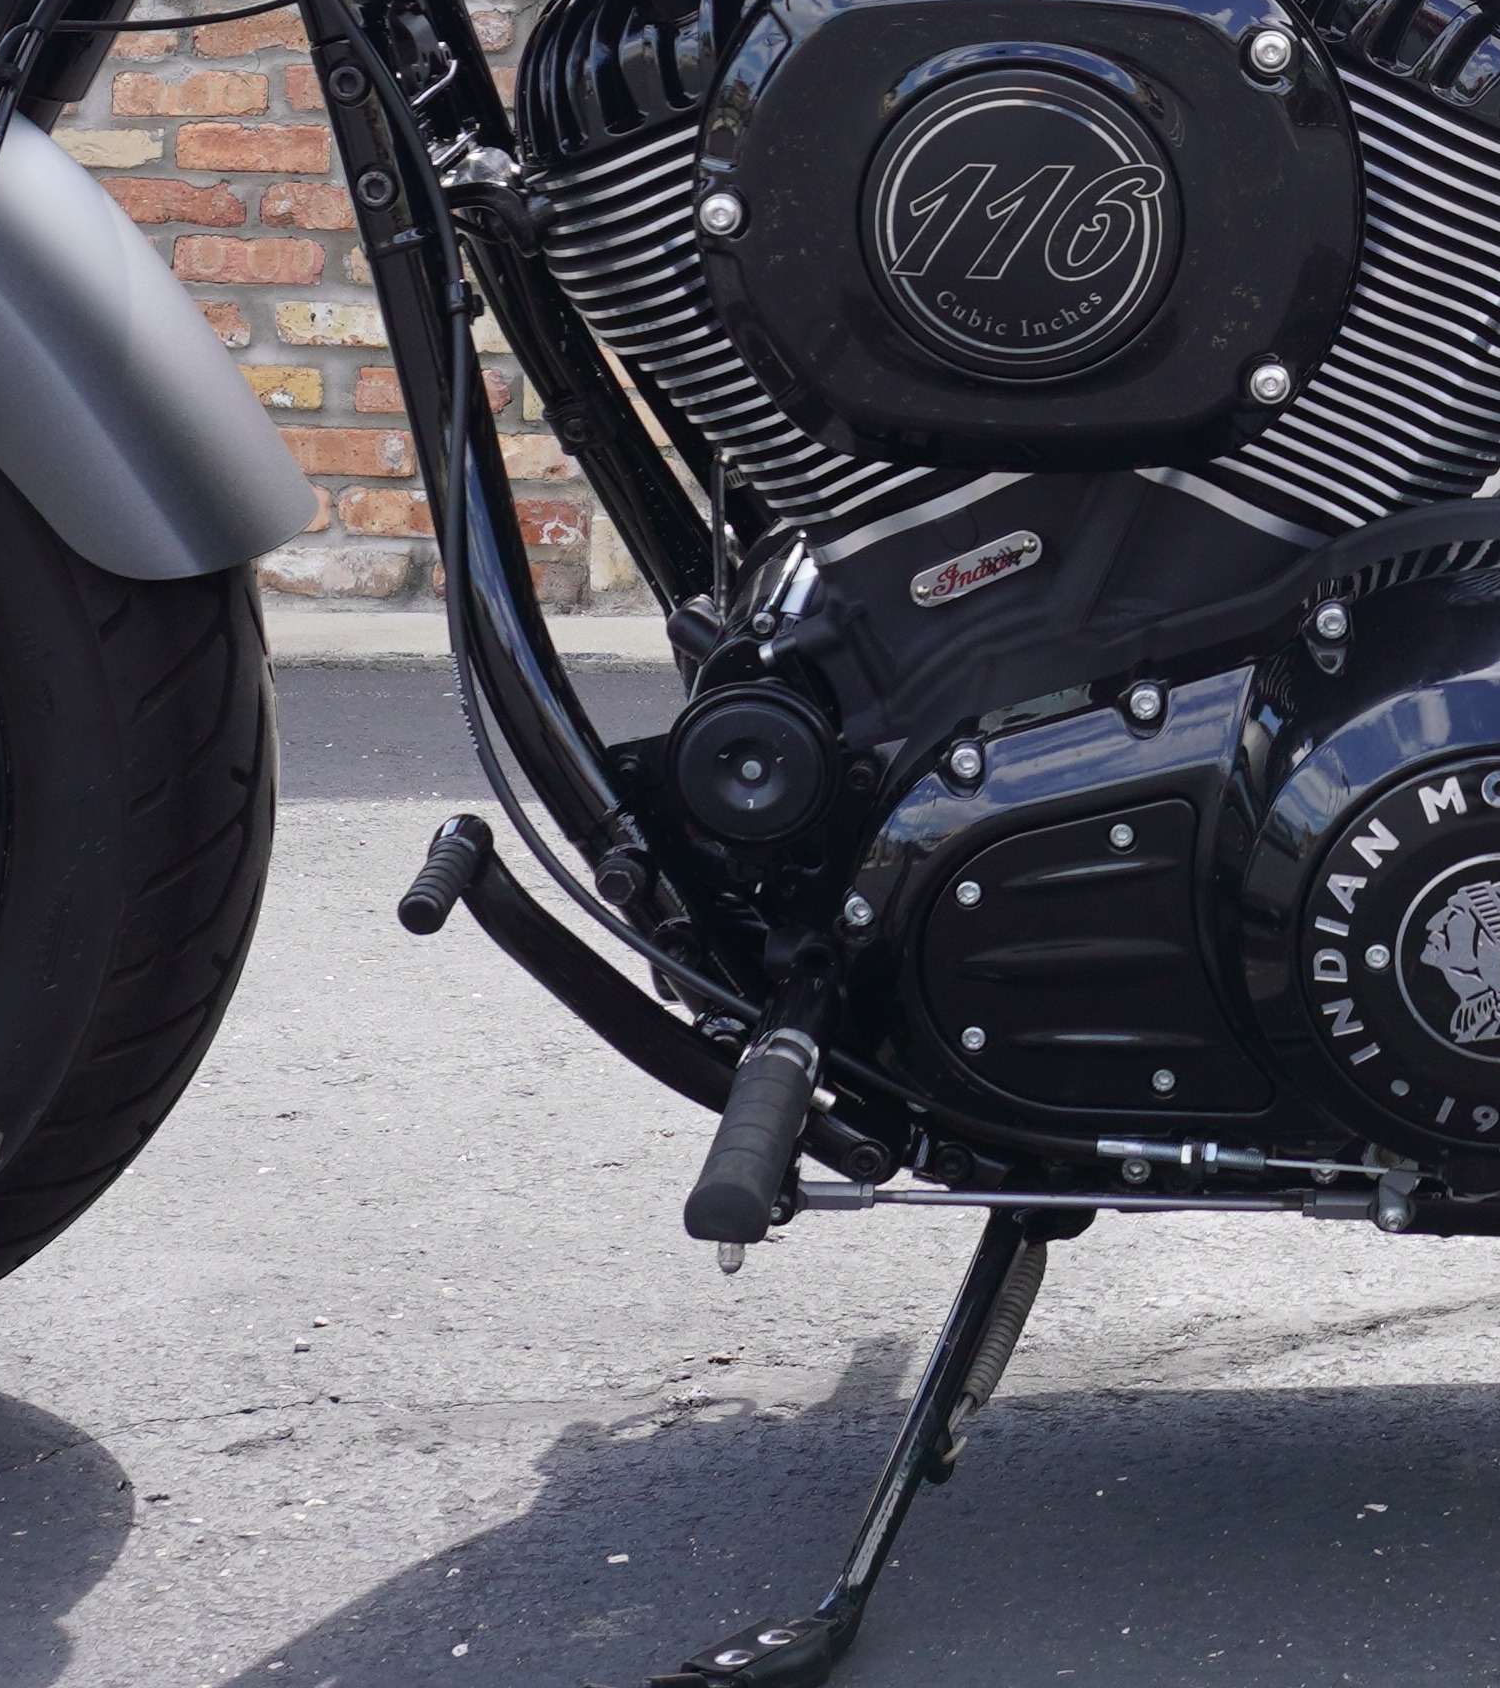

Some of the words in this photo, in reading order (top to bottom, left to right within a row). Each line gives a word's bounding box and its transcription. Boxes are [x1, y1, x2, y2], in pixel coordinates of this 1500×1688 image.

[889, 163, 1166, 282] 116
[936, 289, 1008, 338] Cubic
[1020, 290, 1104, 338] Inches
[932, 548, 1025, 597] Indian
[1312, 817, 1401, 1067] INDIAN
